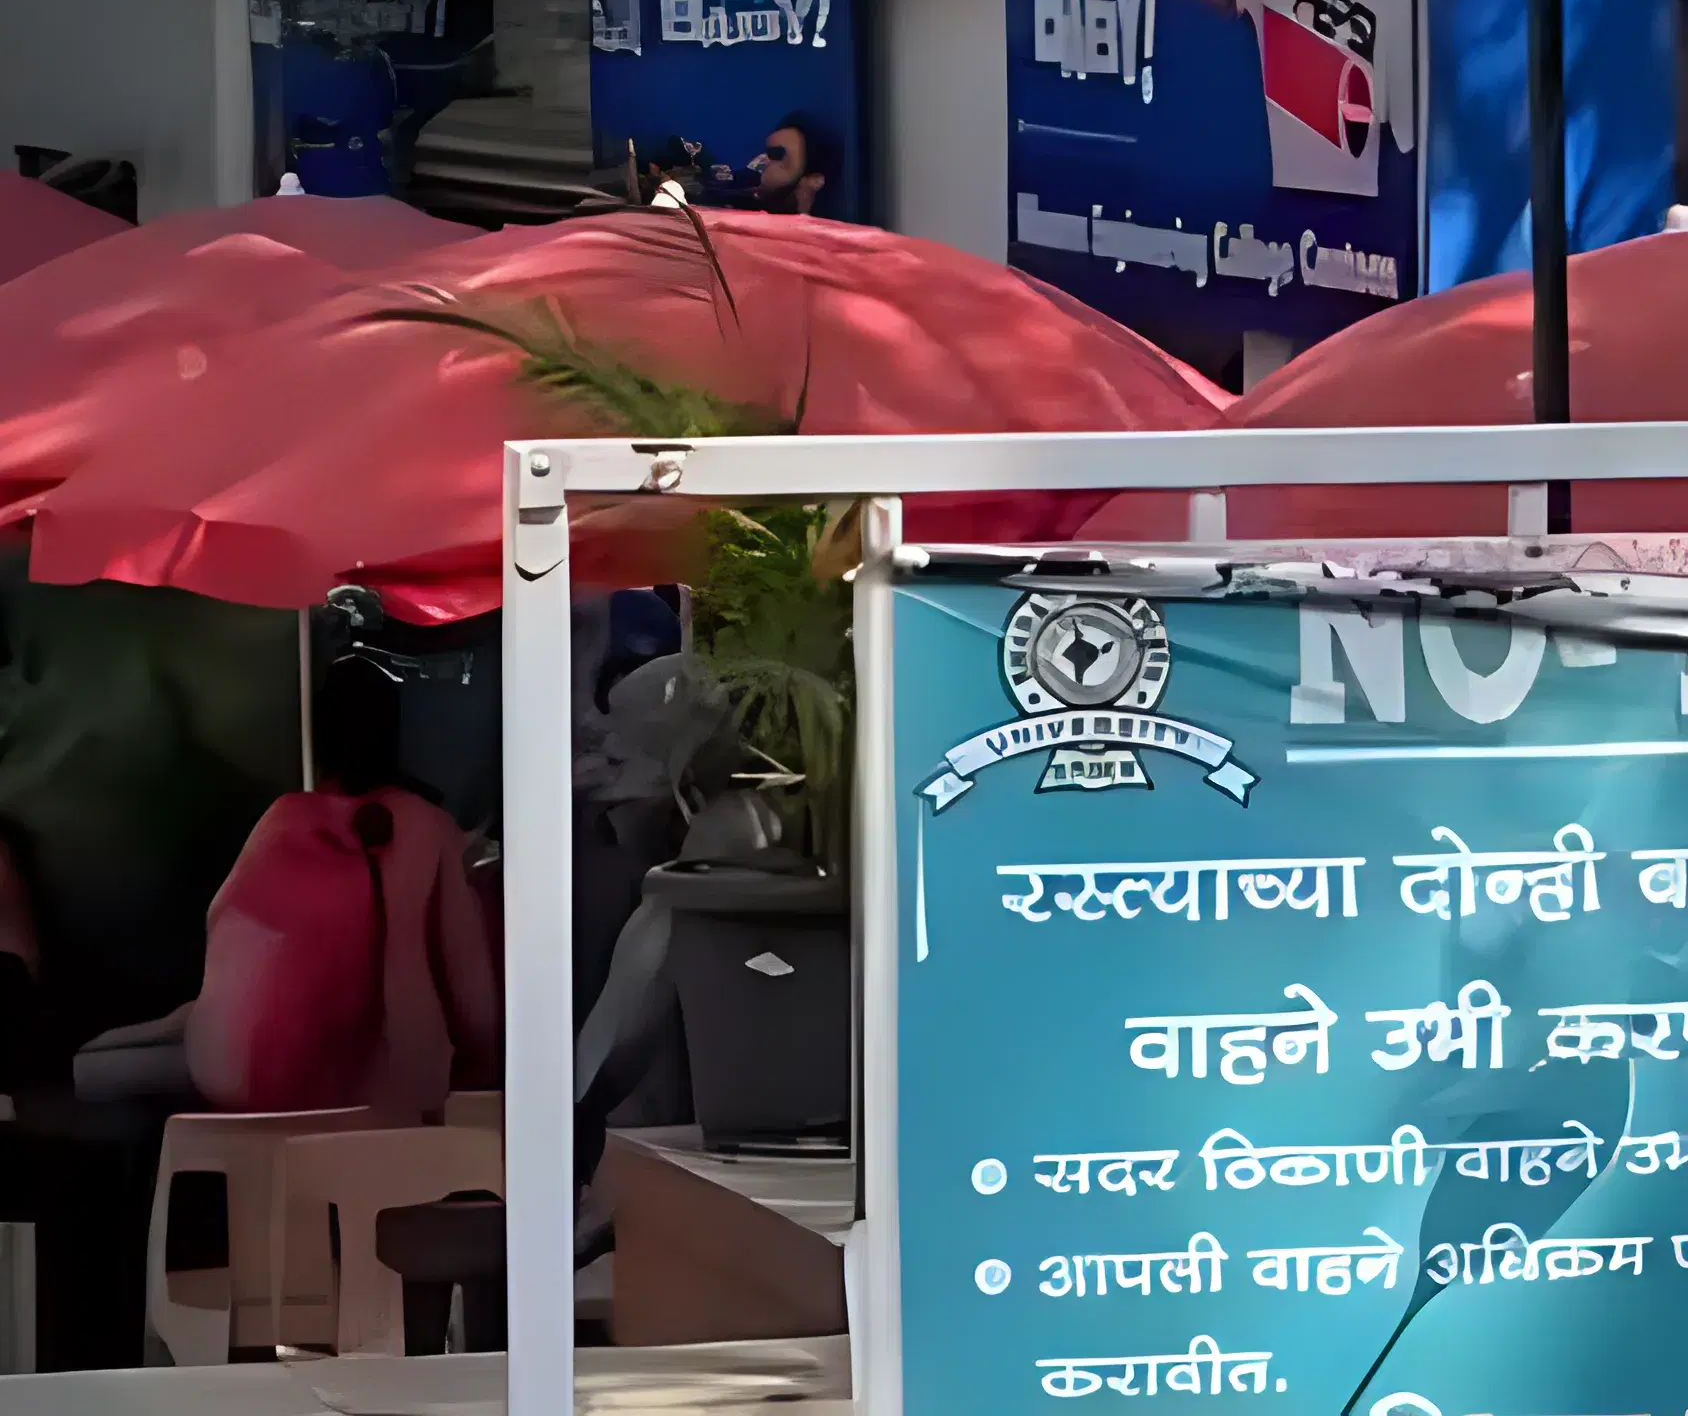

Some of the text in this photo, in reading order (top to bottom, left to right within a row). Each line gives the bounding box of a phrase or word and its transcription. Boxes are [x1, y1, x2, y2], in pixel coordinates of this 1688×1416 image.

[1125, 984, 1338, 1084] वाहने
[1365, 980, 1511, 1070] उभी
[1040, 1232, 1228, 1296] आपली
